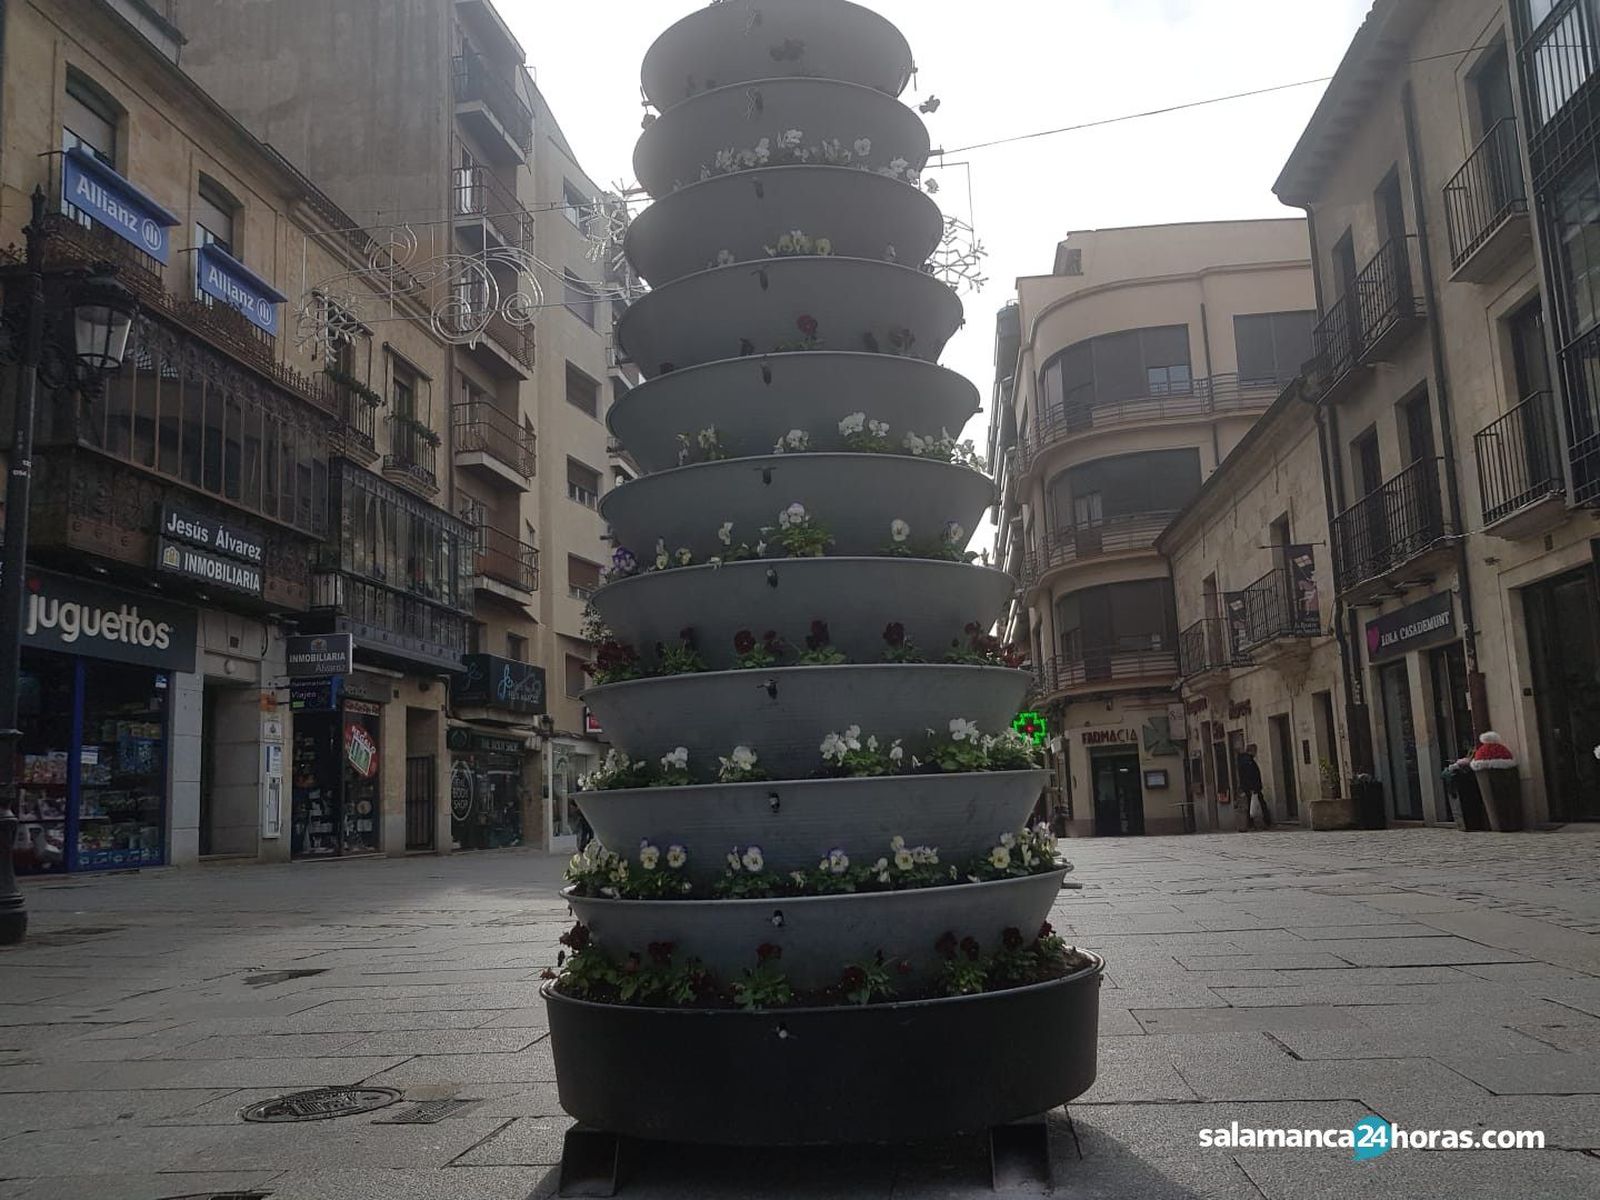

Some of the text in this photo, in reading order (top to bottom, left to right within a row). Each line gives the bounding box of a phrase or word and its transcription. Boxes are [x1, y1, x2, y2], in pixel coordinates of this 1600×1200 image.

[76, 174, 138, 233] Allianz
[208, 265, 255, 312] Allianz
[167, 512, 262, 561] Jesús Álvarez
[184, 552, 260, 592] INMOBILIARIA
[25, 577, 171, 649] juguettos
[1399, 611, 1450, 640] CASADEMUNT
[289, 651, 346, 664] INMOBILIARIA
[1081, 729, 1138, 745] FARMACIA
